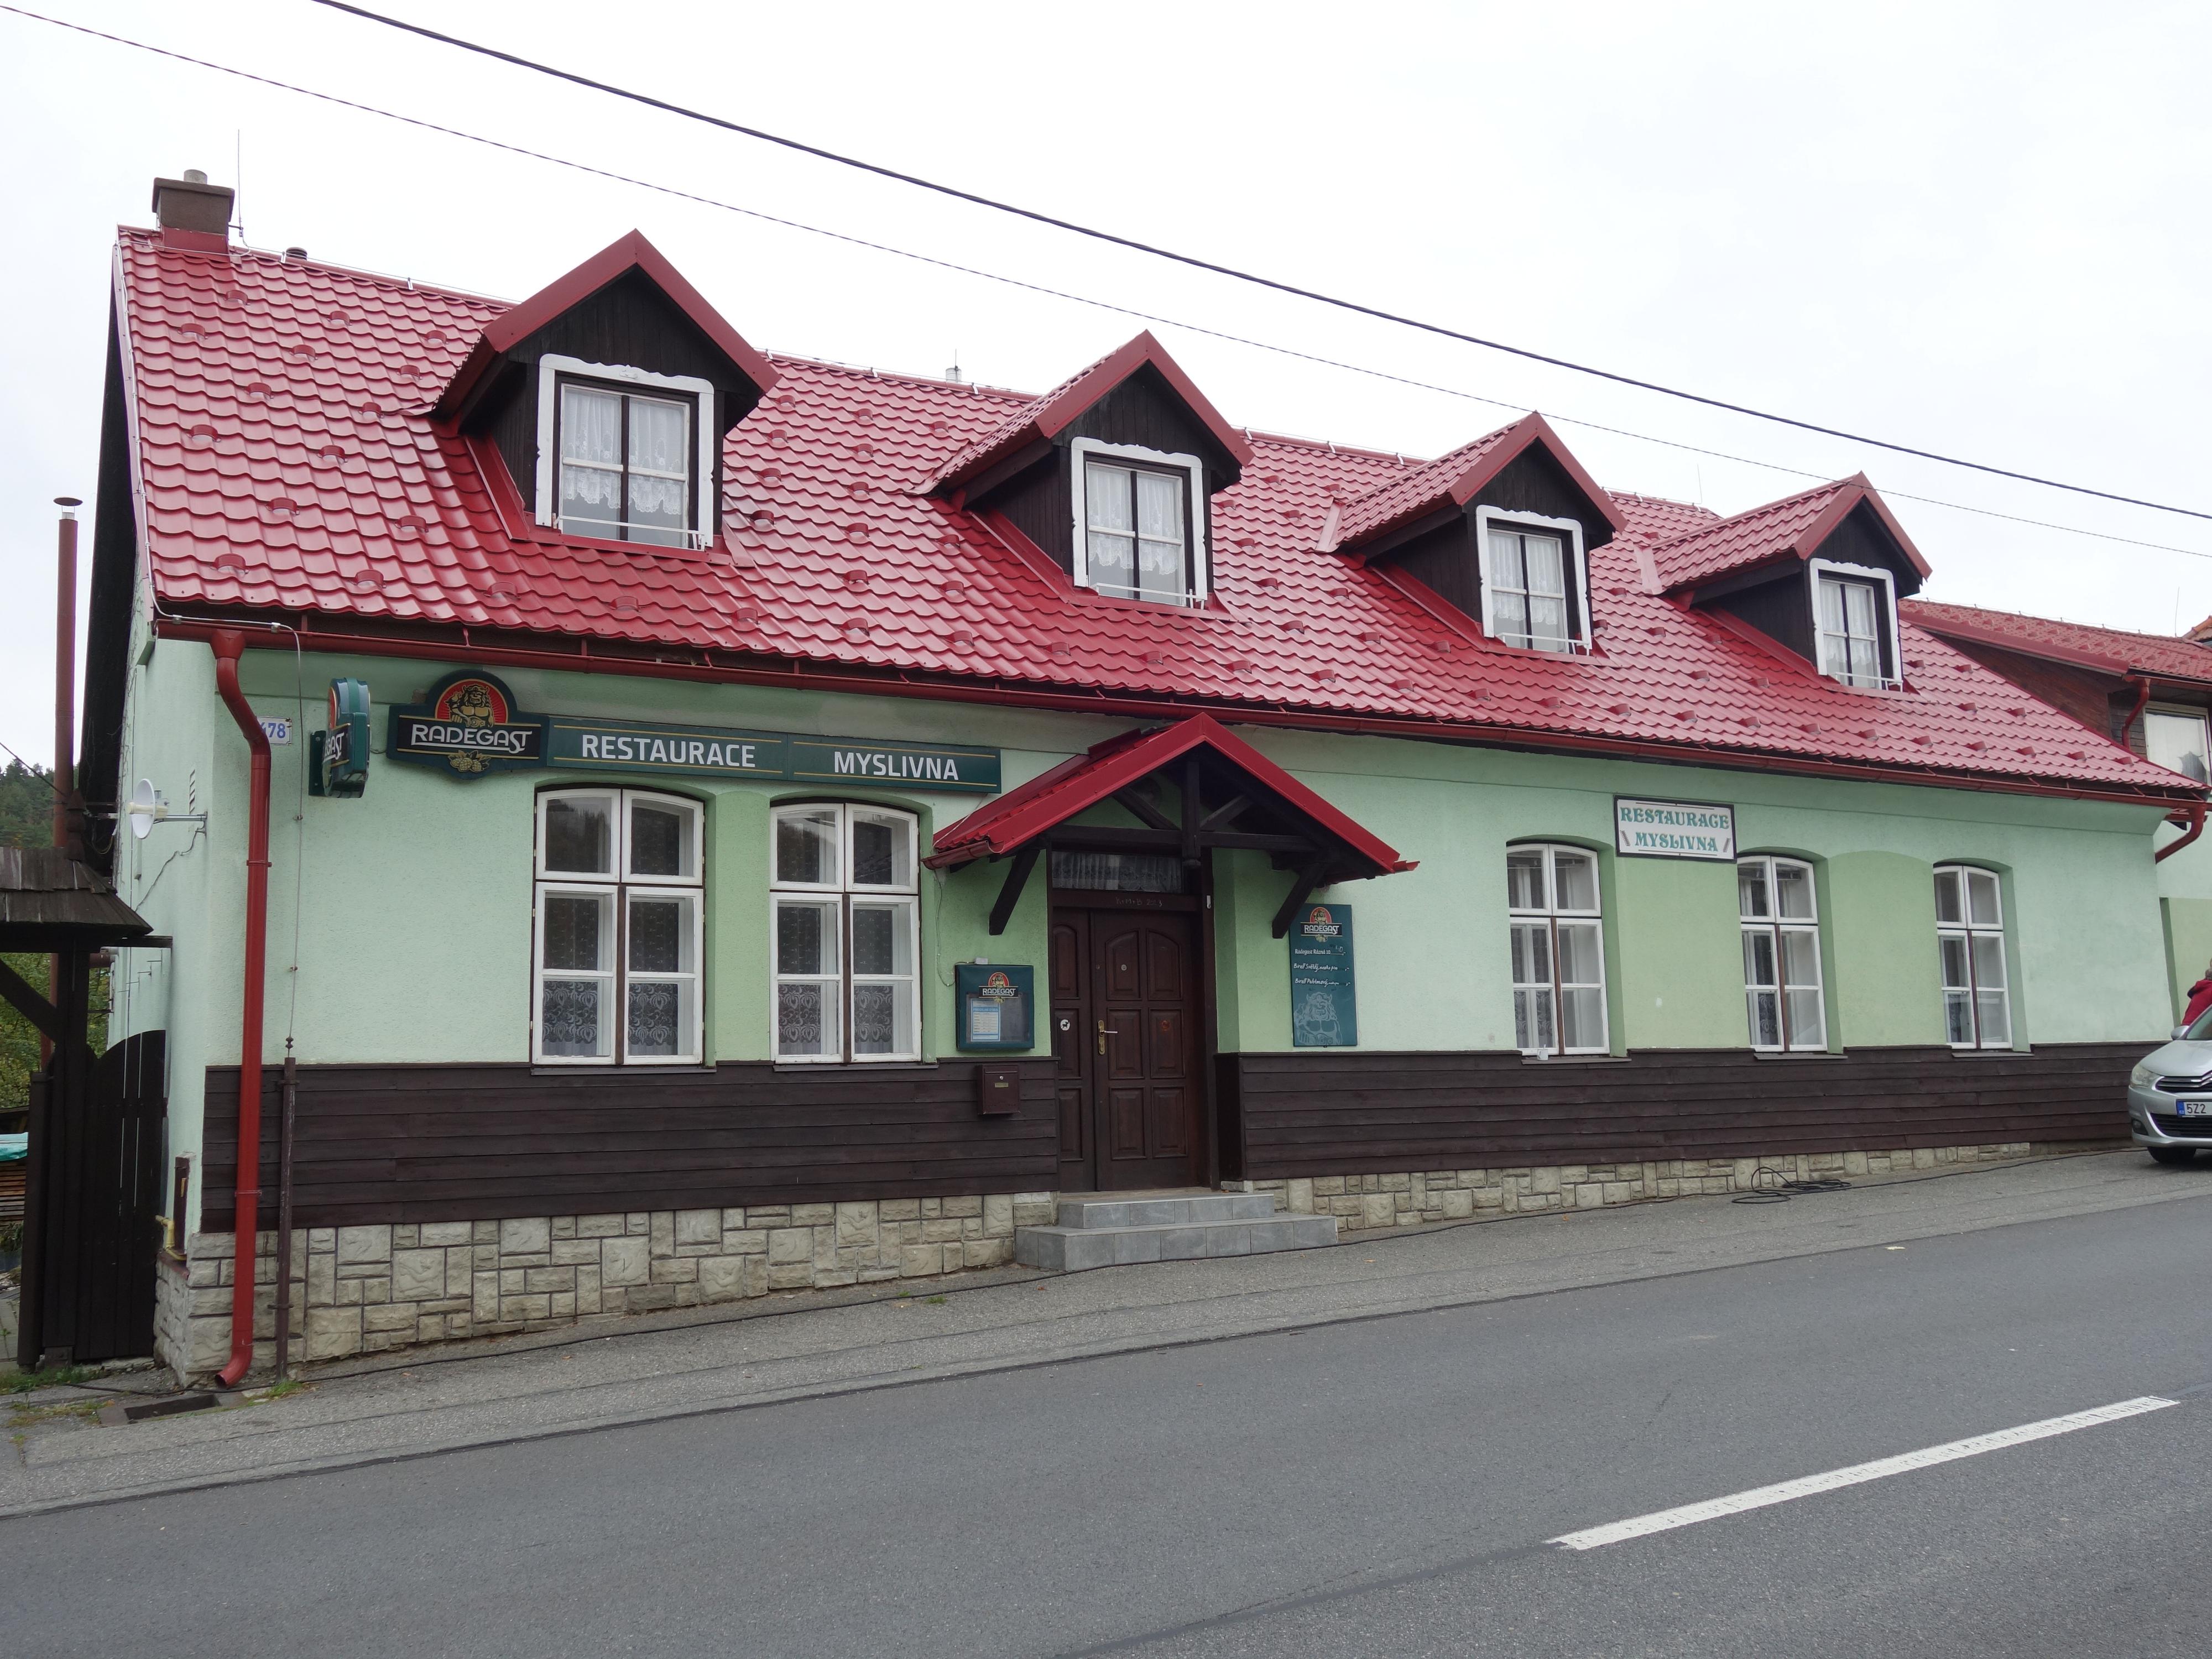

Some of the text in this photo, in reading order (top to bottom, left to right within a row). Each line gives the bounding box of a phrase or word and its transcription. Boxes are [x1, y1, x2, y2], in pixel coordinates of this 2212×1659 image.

[411, 724, 533, 754] RADEGAST
[582, 734, 959, 780] RESTAURACE MYSLIVNA
[1620, 807, 1730, 830] RESTAURACE
[1635, 832, 1719, 852] MYSLIVNA
[1304, 925, 1339, 935] RADEGAST
[982, 988, 1016, 997] RADEGAST
[2186, 1103, 2206, 1114] 5Z2
